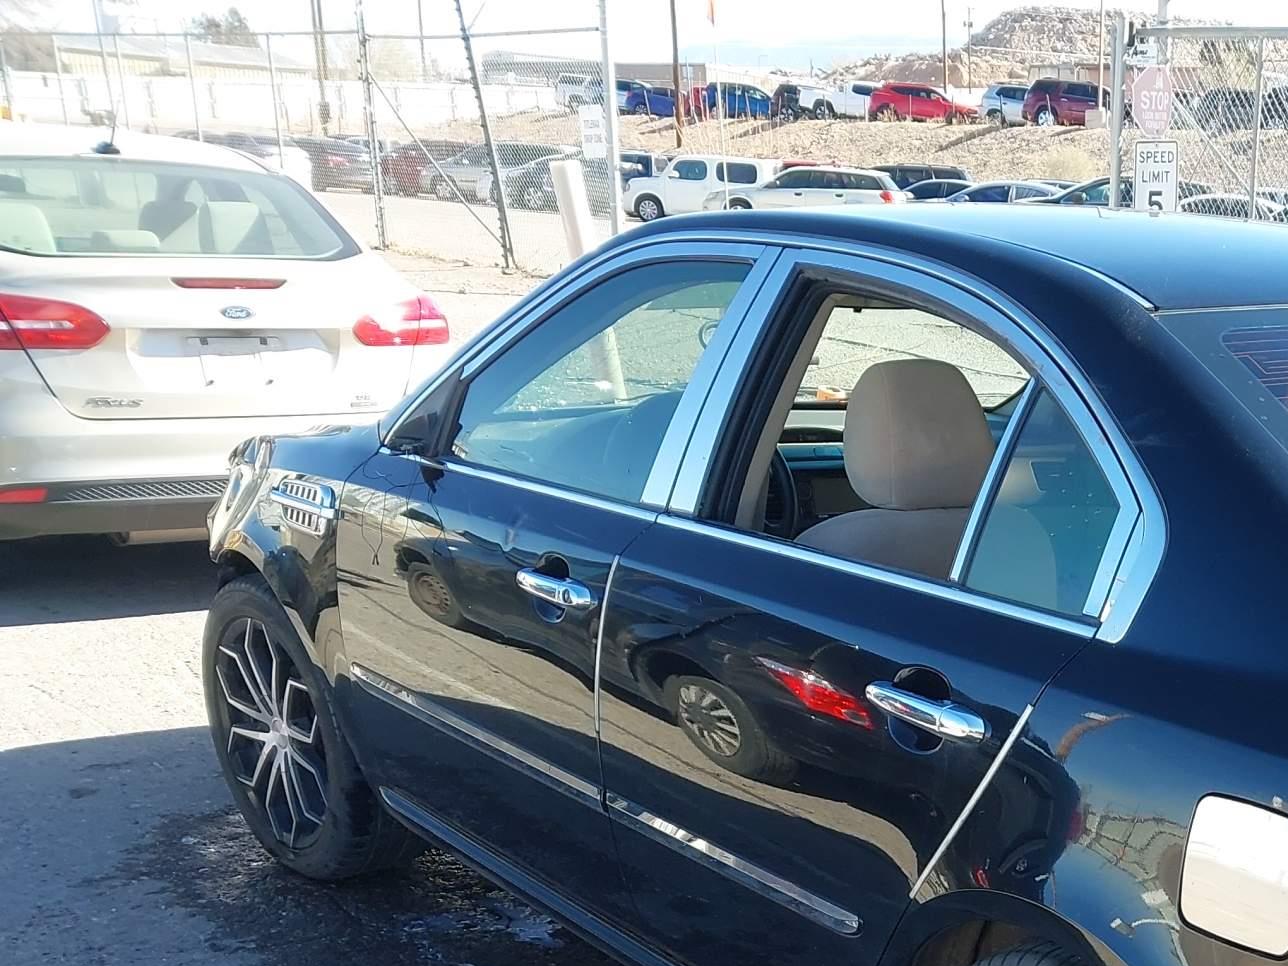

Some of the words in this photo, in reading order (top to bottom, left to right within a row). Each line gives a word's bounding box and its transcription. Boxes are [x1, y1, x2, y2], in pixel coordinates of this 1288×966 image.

[1140, 90, 1170, 111] STOP
[1138, 150, 1175, 164] SPEED
[1141, 170, 1171, 183] LIMIT
[1148, 190, 1163, 212] 5
